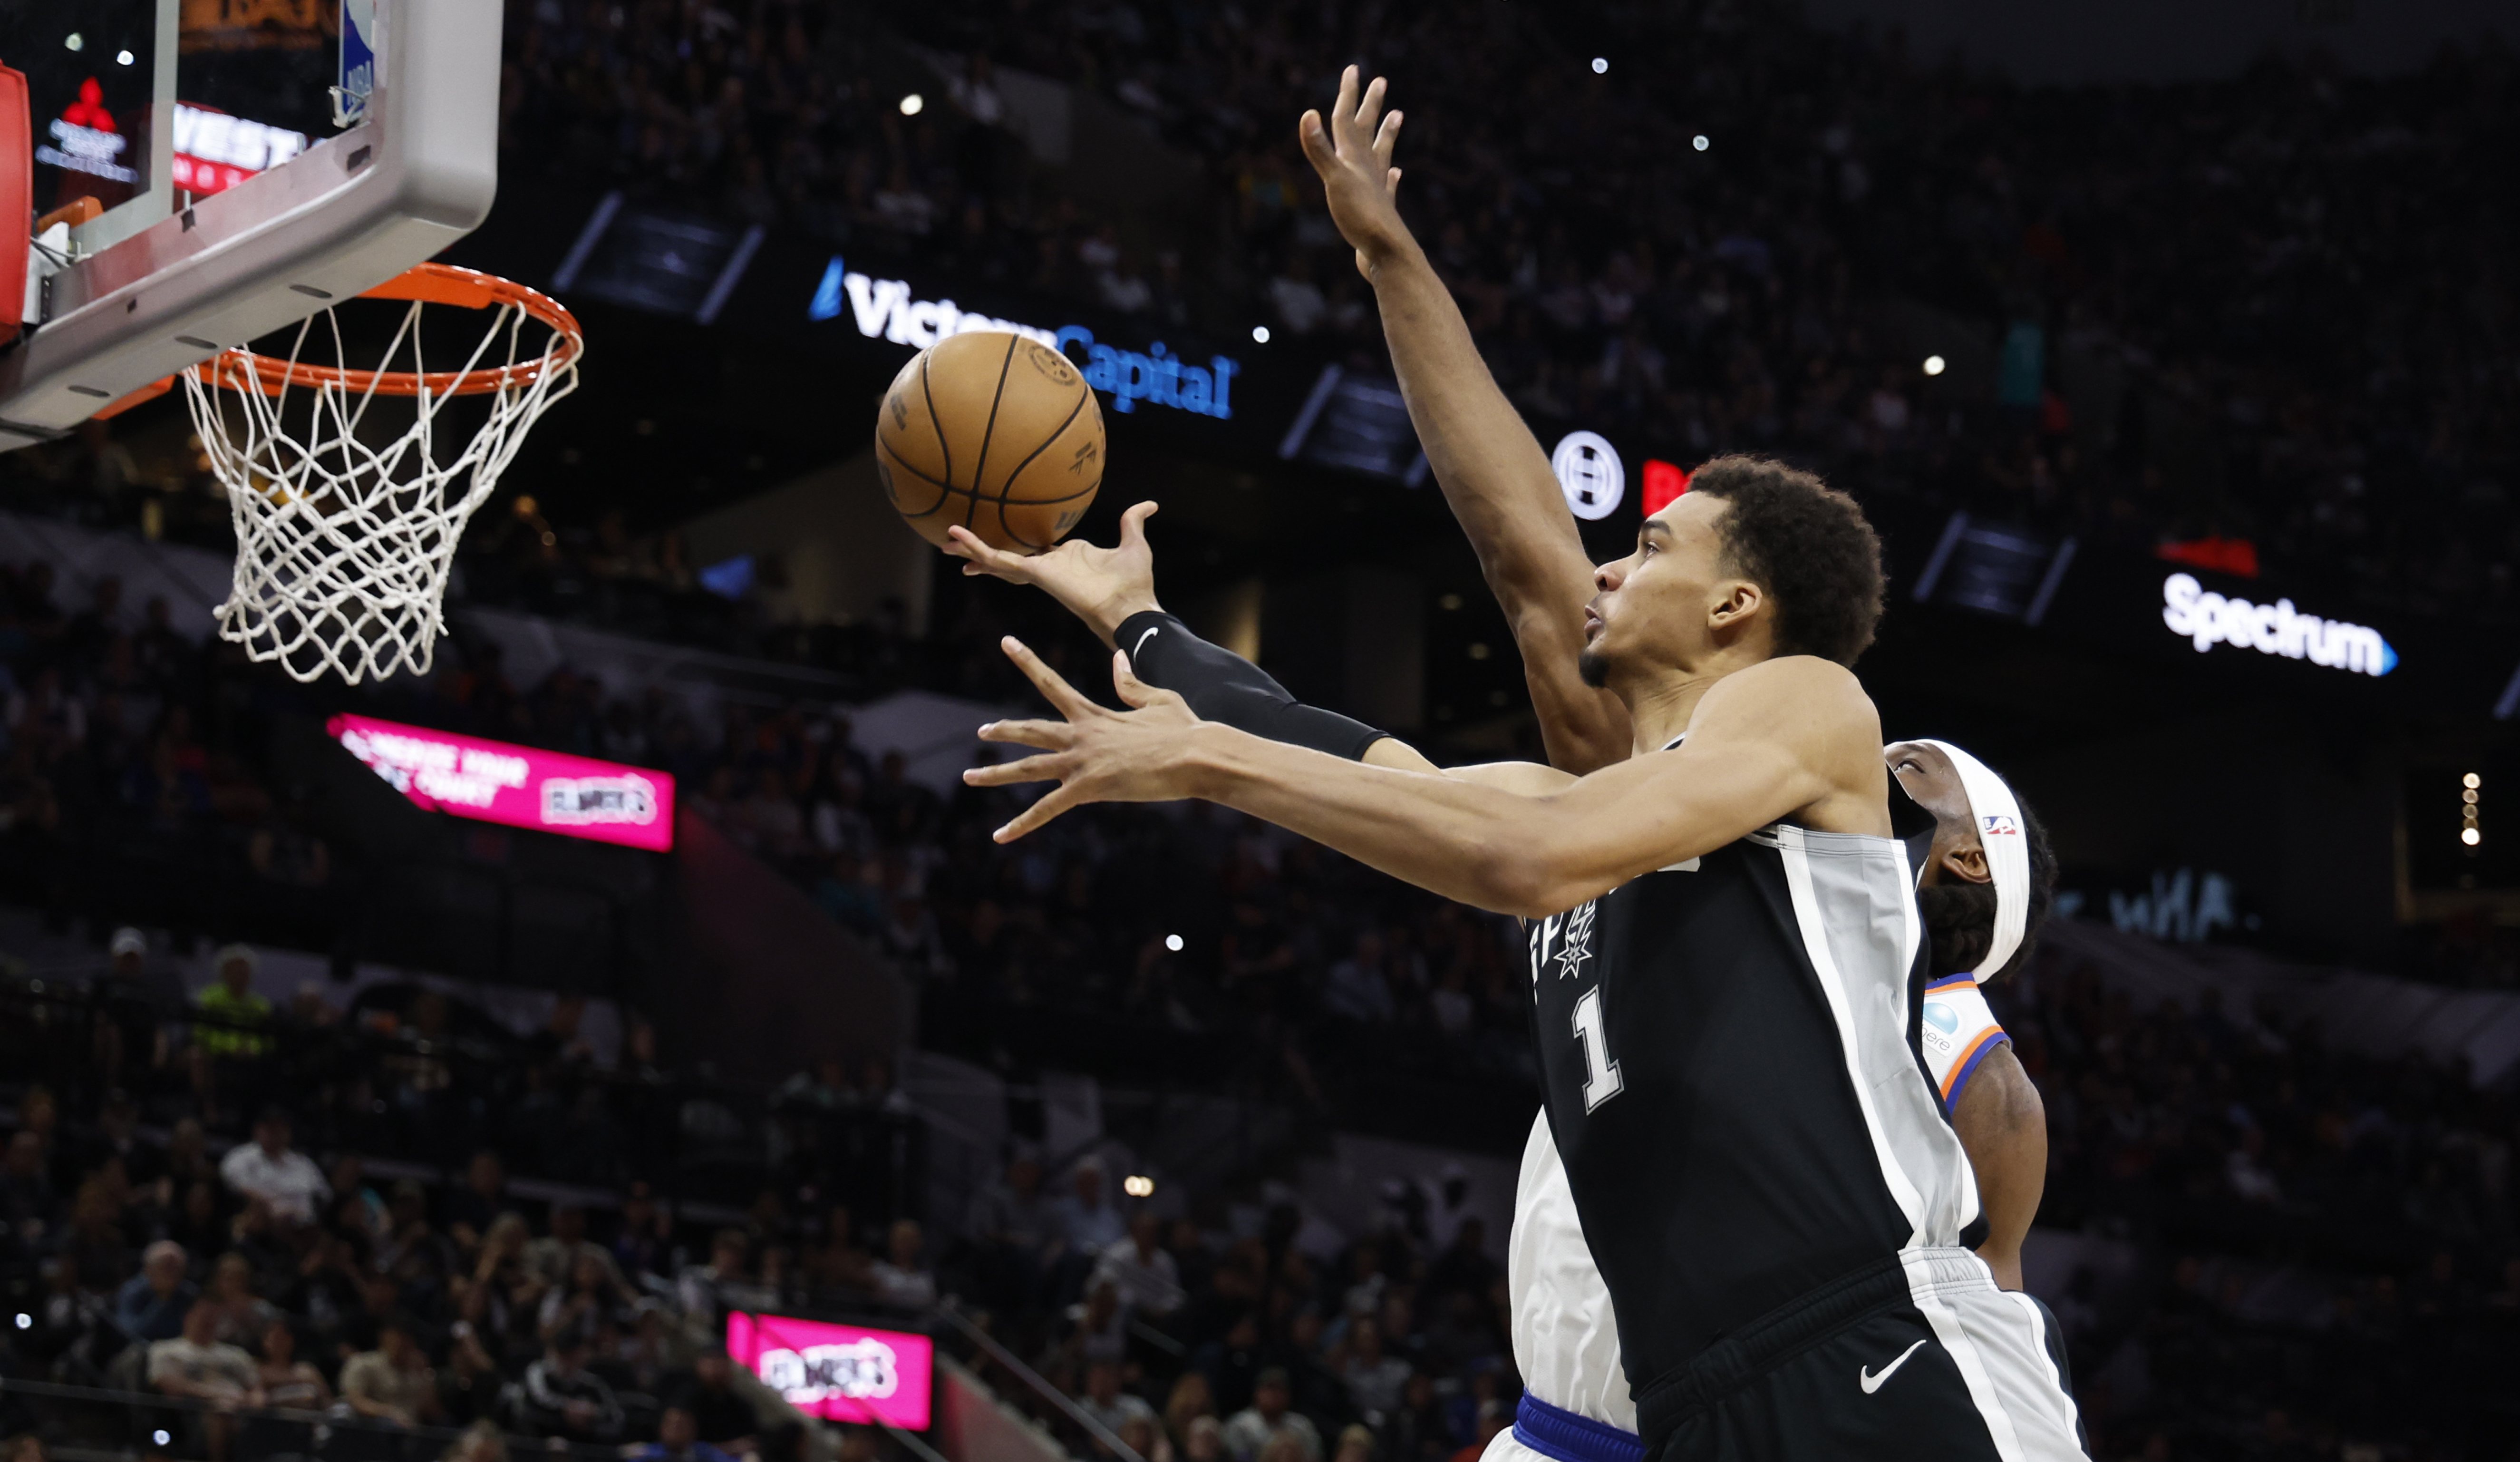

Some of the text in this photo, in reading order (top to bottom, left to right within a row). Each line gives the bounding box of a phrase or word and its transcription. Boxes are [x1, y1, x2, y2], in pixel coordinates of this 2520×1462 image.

[844, 273, 1057, 349] Vict
[2162, 573, 2385, 677] Spectrum
[1571, 984, 1624, 1116] 1
